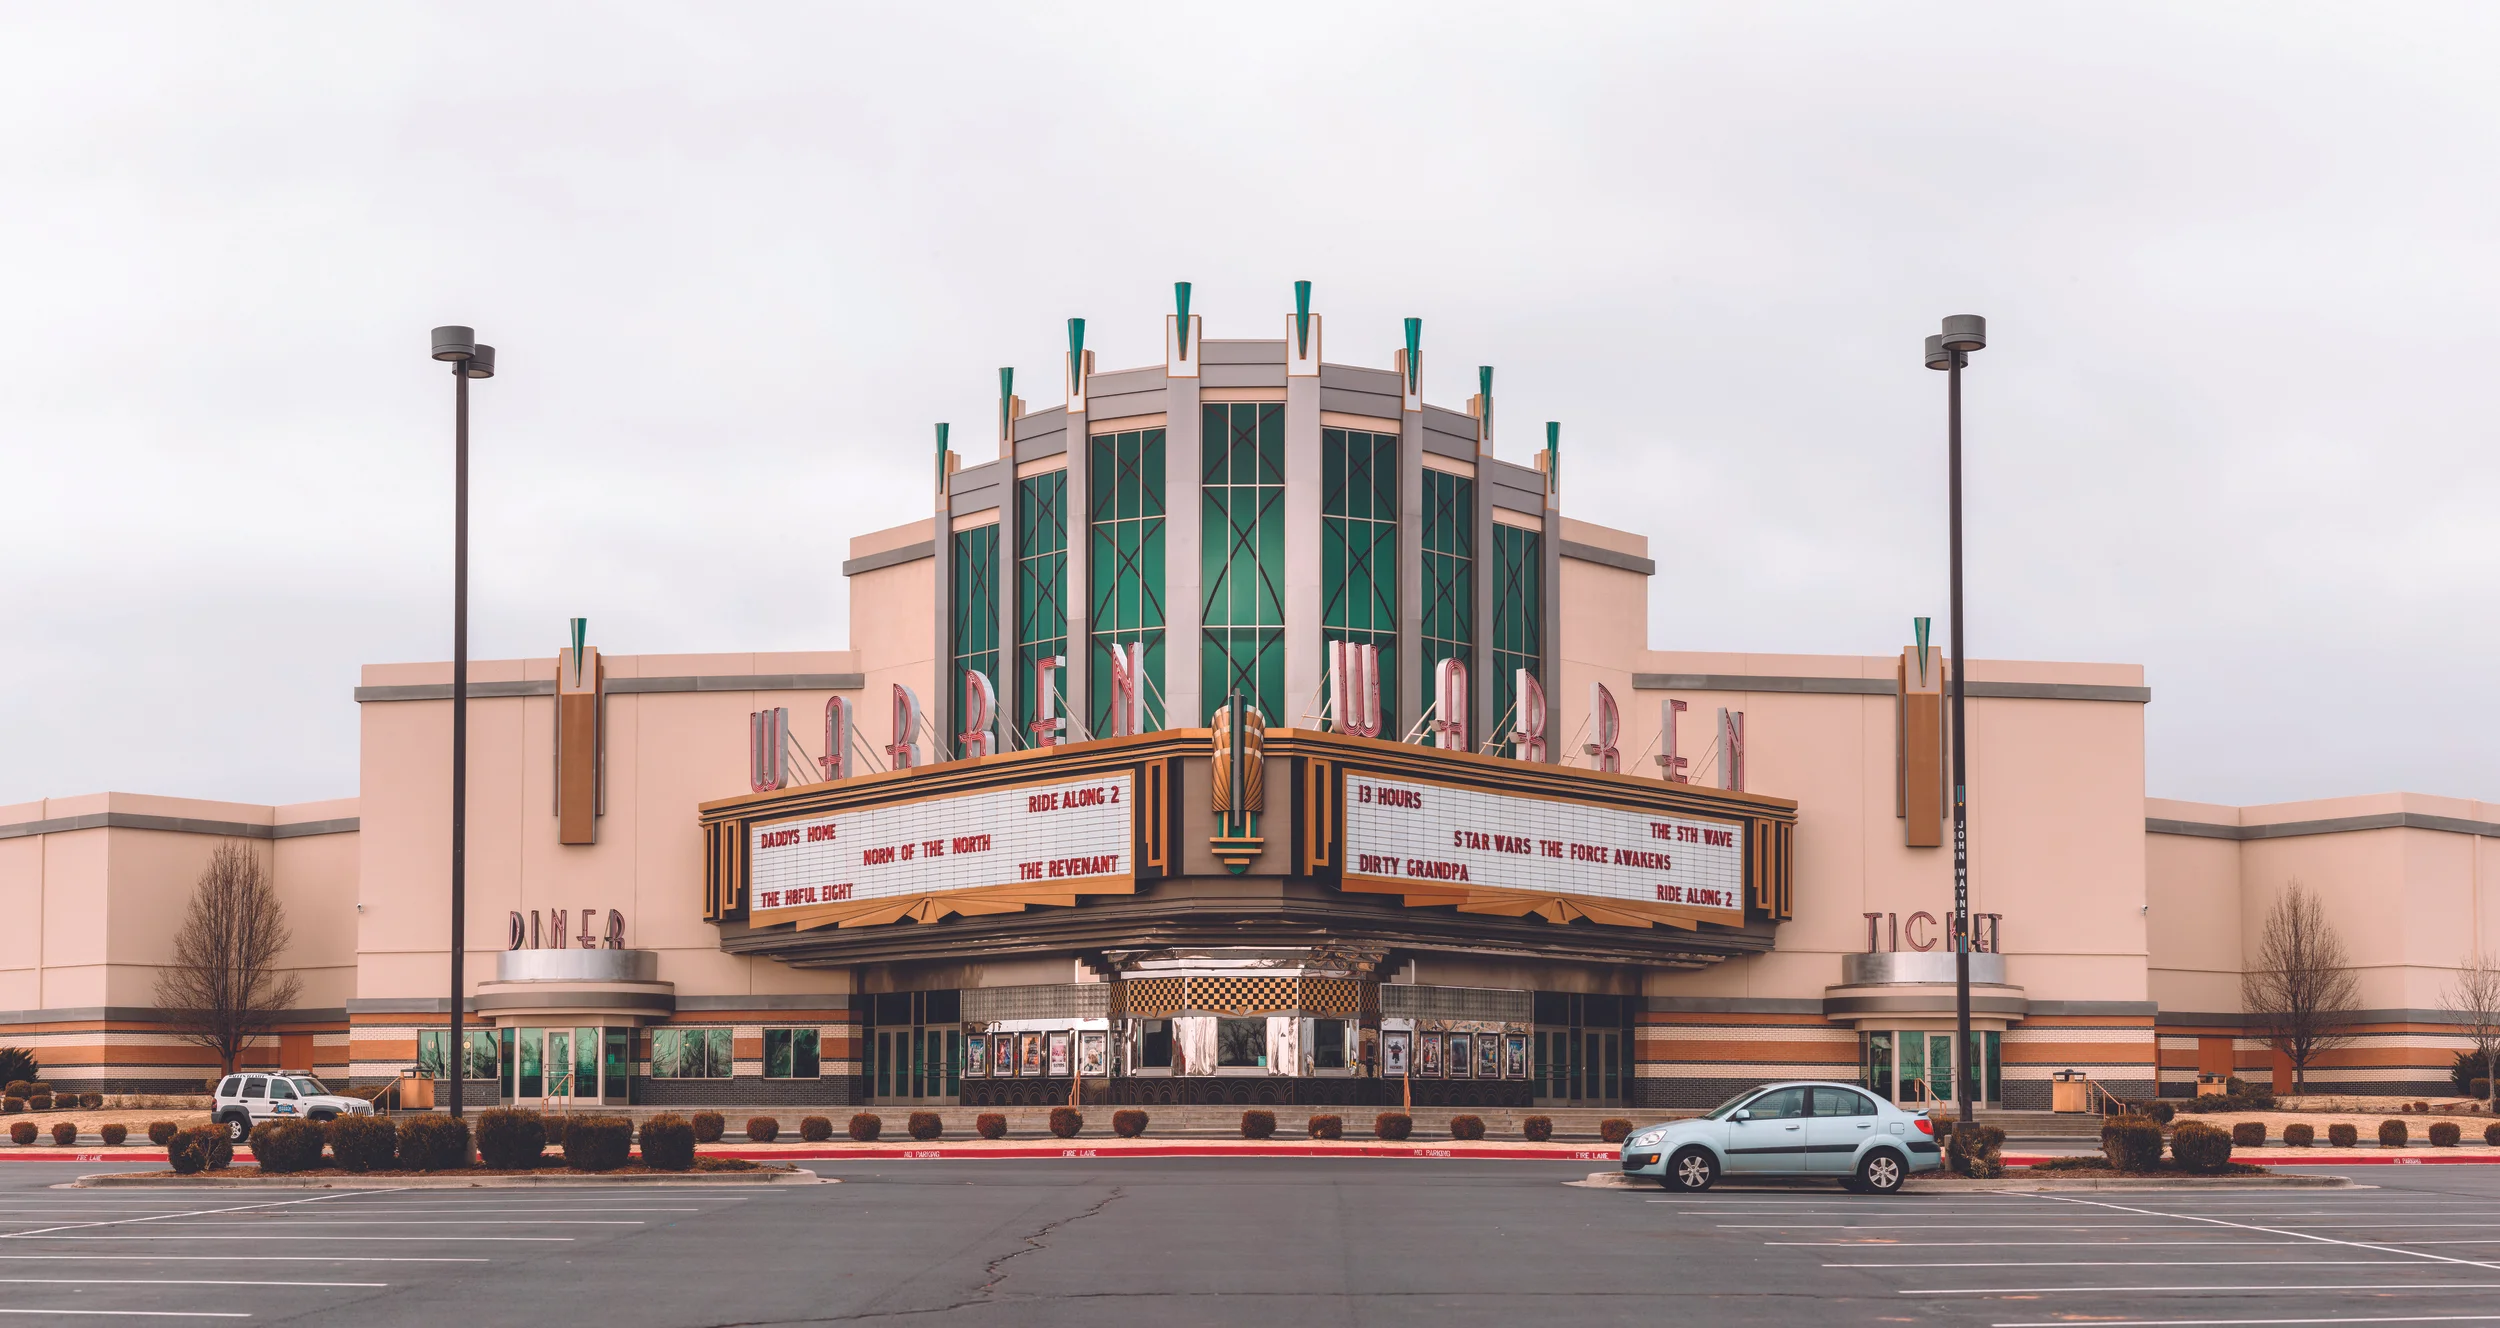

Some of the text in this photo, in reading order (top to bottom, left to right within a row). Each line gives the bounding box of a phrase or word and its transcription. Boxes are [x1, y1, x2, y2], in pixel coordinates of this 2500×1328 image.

[750, 642, 1143, 794] WARREN
[1329, 640, 1744, 793] WARREN
[1029, 786, 1119, 812] RIDE ALONG 2
[1359, 785, 1421, 808] 13 HOURS
[762, 824, 836, 848] DADDYS HOME
[1651, 823, 1732, 847] THE 5TH WAVE
[864, 834, 990, 866] NORM OF THE NORTH
[1455, 831, 1670, 870] STAR WARS THE FORCE AWAKENS
[1019, 855, 1119, 880] THE REVENANT
[1359, 854, 1469, 881] DIRTY GRANDPA
[1957, 820, 1966, 918] JOHN WAYNE
[761, 883, 853, 908] THE H8FUL EIGHT
[1656, 885, 1732, 906] RIDE ALONG 2
[508, 908, 626, 950] DINER
[1593, 1152, 1609, 1160] LANE
